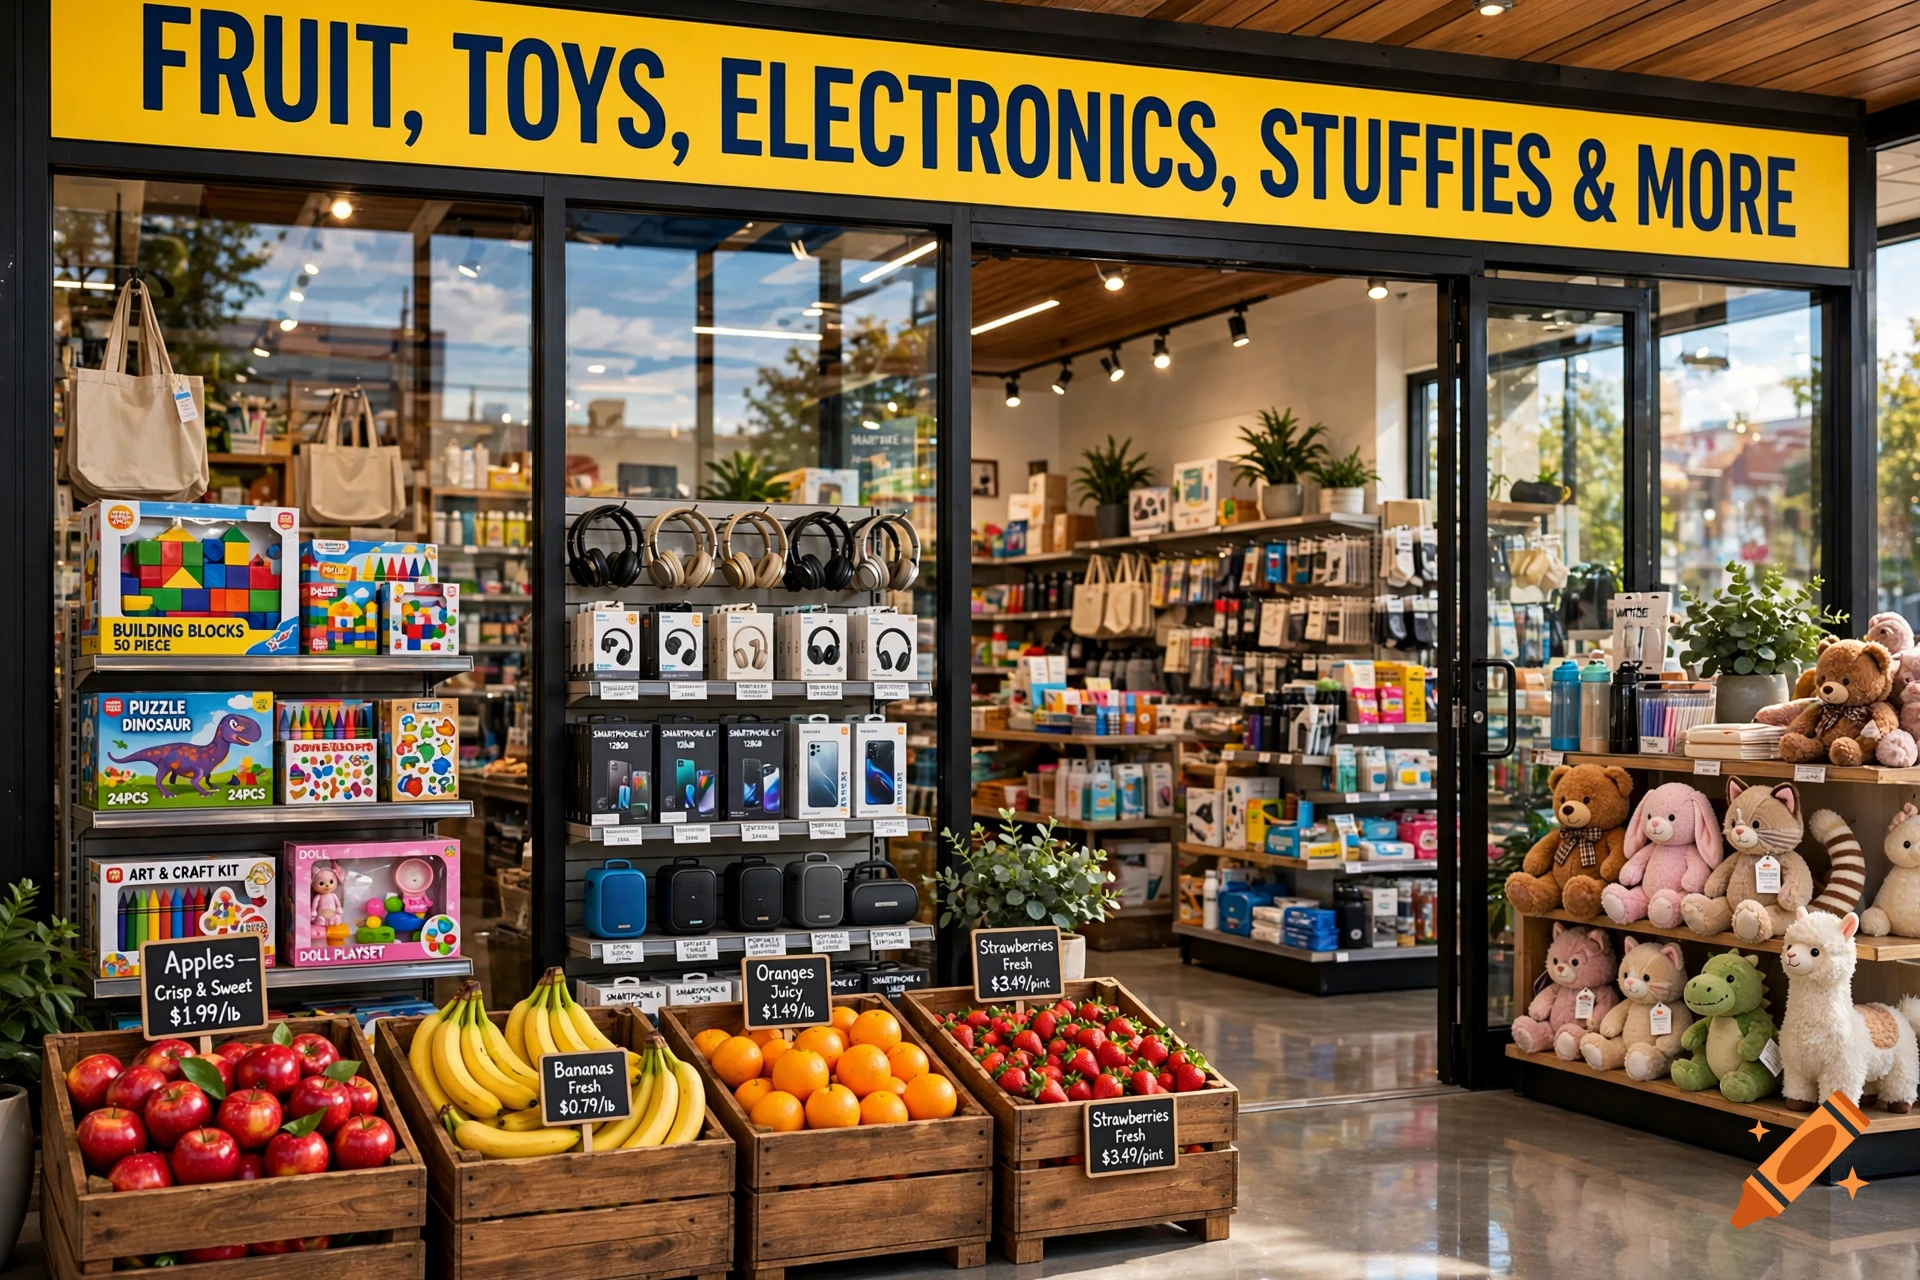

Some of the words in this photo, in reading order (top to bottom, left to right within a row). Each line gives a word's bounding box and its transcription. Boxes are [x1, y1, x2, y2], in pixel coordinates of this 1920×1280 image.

[142, 3, 423, 147] FRUIT,
[453, 33, 690, 166] TOYS,
[721, 57, 1236, 208] ELECTRONICS,
[1260, 108, 1552, 218] STUFFIES
[1573, 138, 1617, 223] &
[1638, 144, 1797, 238] MORE
[113, 623, 184, 638] BUILDING
[192, 624, 244, 638] BLOCKS
[114, 640, 130, 651] 50
[134, 640, 171, 651] PIECE
[129, 700, 186, 715] PUZZLE
[122, 718, 191, 732] DINOSAUR
[107, 793, 149, 806] 24PCS
[227, 789, 266, 801] 24PCS
[299, 850, 329, 859] DOLL
[129, 868, 155, 881] ART
[159, 867, 169, 880] &
[172, 865, 214, 879] CRAFT
[218, 864, 239, 877] KIT
[299, 950, 331, 962] DOLL
[334, 945, 386, 960] PLAYSET
[980, 938, 1054, 955] Strawberries
[164, 947, 235, 980] Apples
[1003, 957, 1033, 971] Fresh
[756, 964, 815, 986] Oranges
[154, 984, 193, 1004] Crisp
[196, 981, 207, 997] &
[211, 978, 253, 996] Sweet
[991, 975, 1051, 993] $3.49/pint
[770, 984, 803, 1002] Juicy
[170, 1001, 241, 1027] $1.99/lb
[762, 1002, 815, 1021] $1.49/lb
[553, 1061, 614, 1079] Bananas
[568, 1079, 601, 1095] Fresh
[559, 1095, 616, 1117] $0.79/lb
[1092, 1108, 1169, 1128] Strawberries
[1115, 1127, 1146, 1144] Fresh
[1101, 1146, 1164, 1167] $3.49/pint
